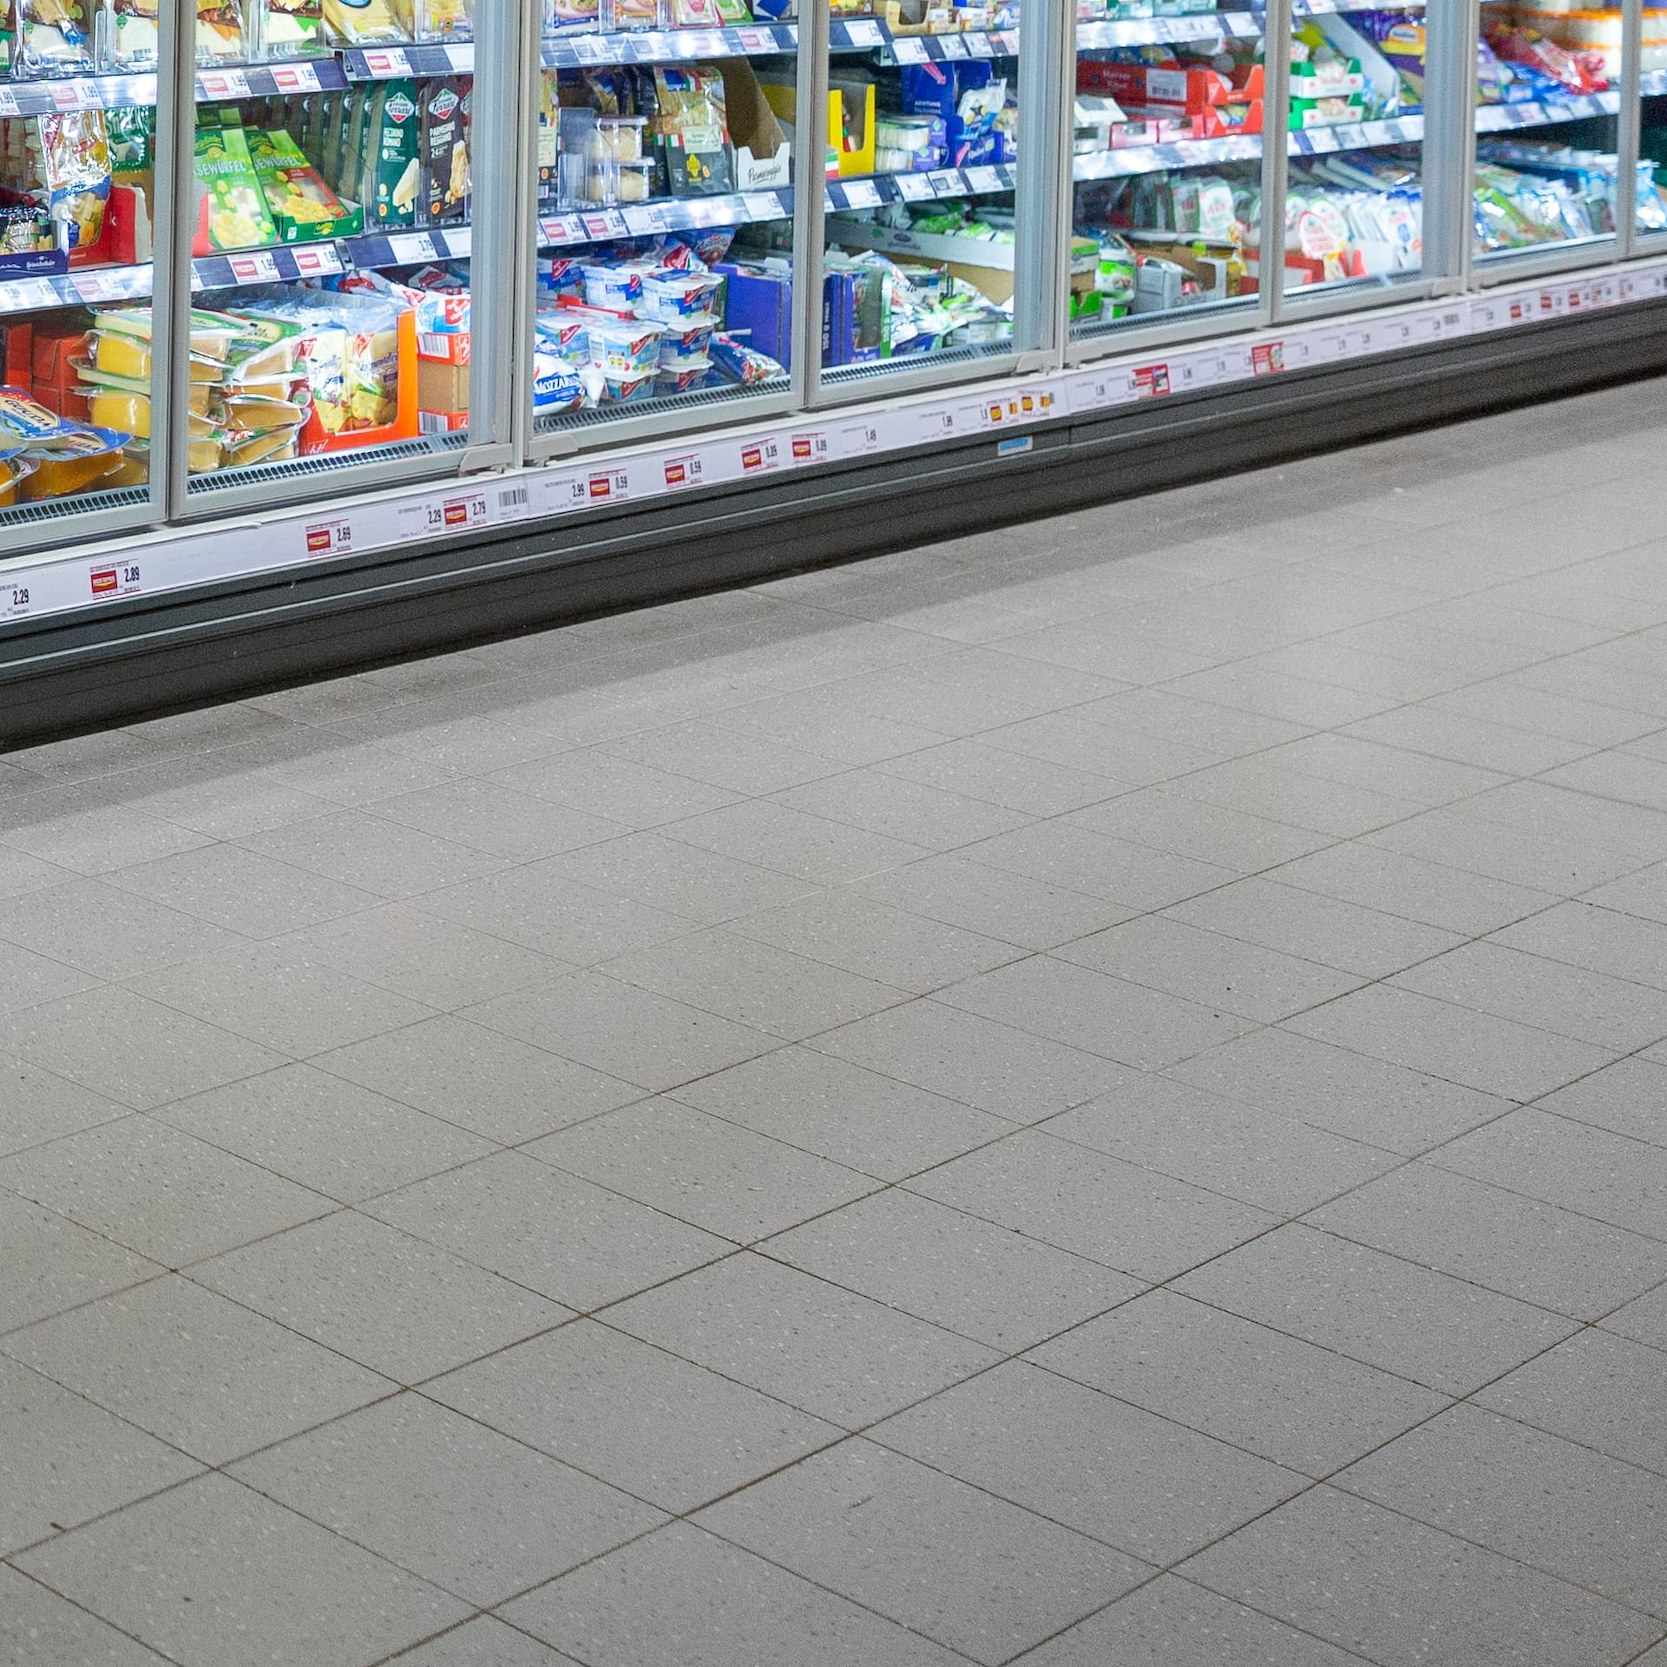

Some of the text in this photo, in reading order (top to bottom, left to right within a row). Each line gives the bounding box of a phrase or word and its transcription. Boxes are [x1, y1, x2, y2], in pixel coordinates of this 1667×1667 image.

[472, 499, 487, 516] 2.79
[124, 565, 141, 584] 2.89
[13, 588, 30, 606] 2.29
